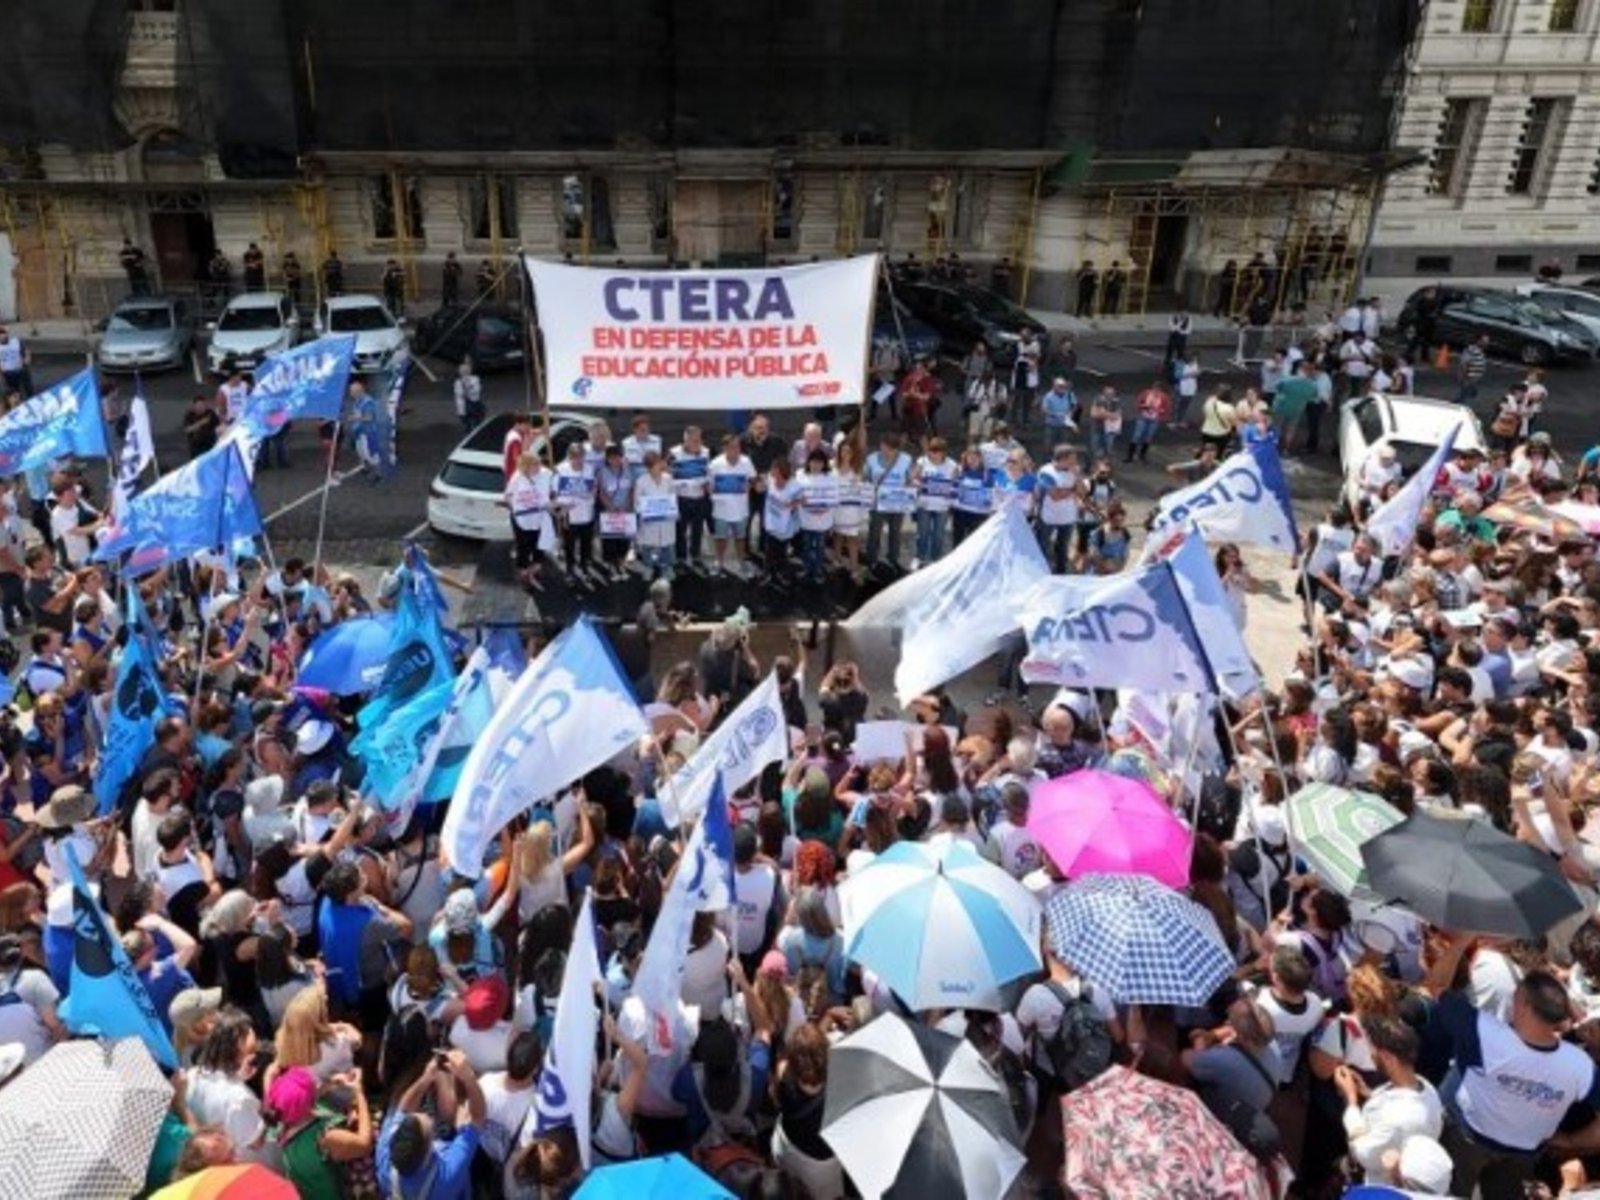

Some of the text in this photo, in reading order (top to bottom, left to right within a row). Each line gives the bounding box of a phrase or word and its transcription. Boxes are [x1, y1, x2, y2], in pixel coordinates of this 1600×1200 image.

[603, 276, 795, 321] CTERA
[593, 324, 818, 350] EN DEFENSA DE LA
[581, 350, 829, 379] EDUCACIÓN PÚBLICA
